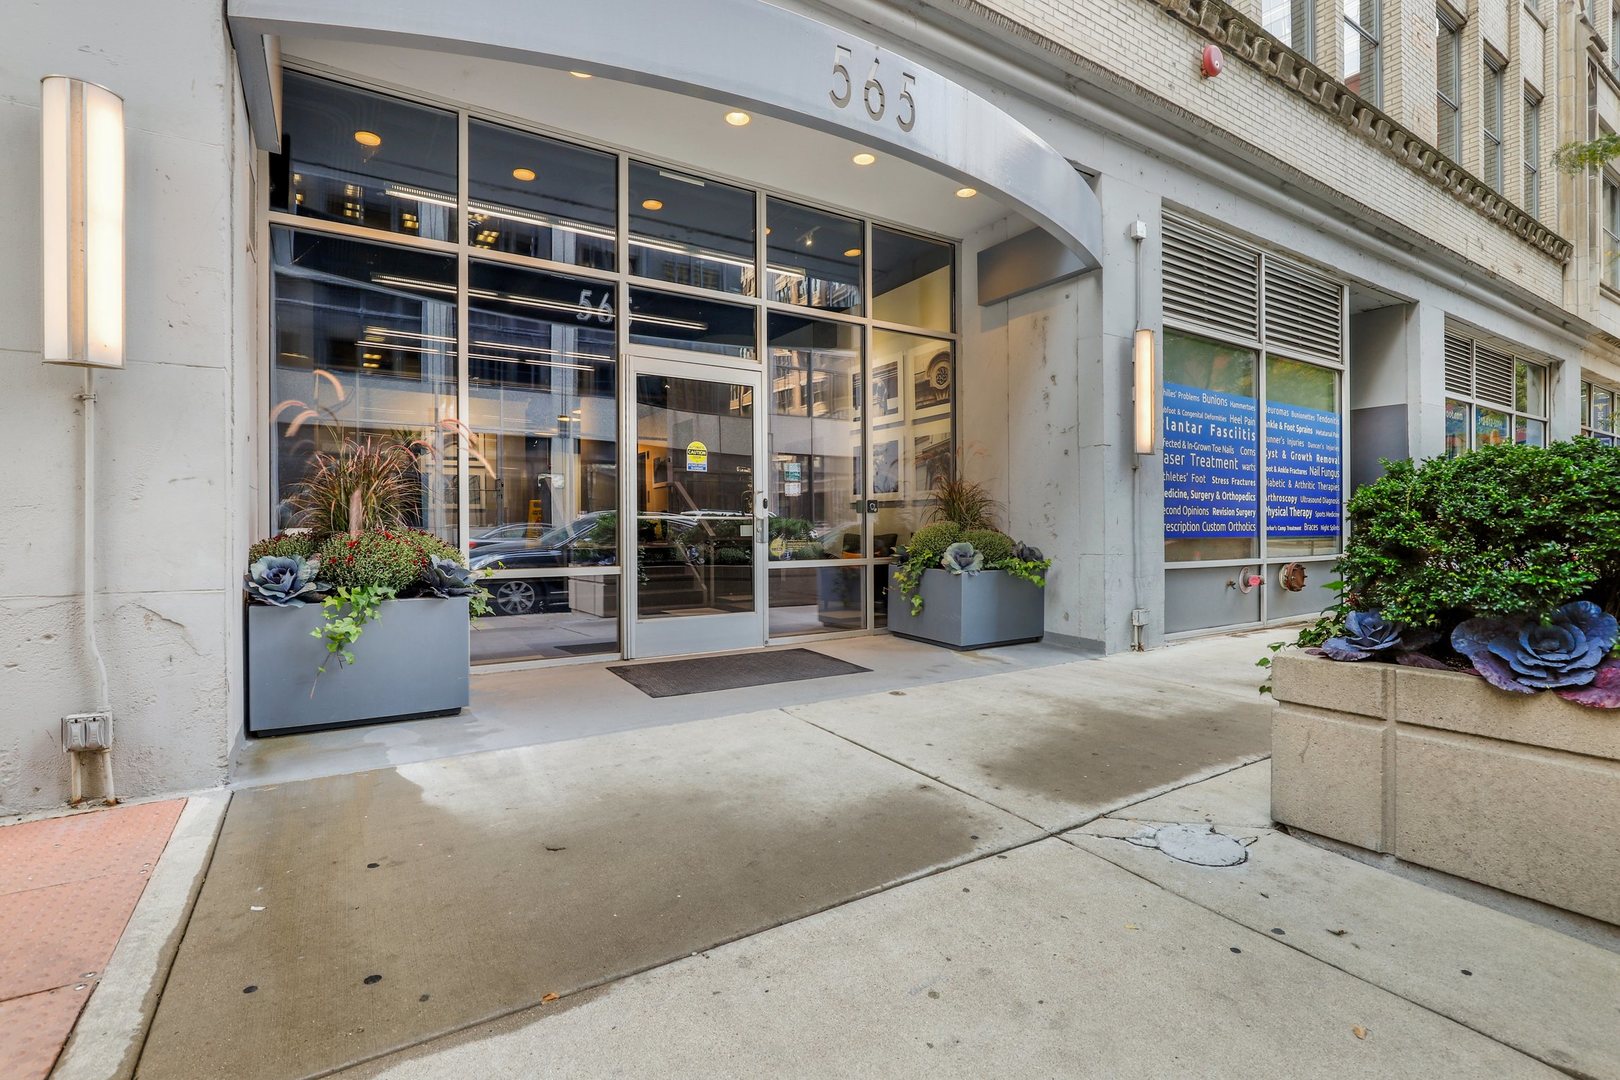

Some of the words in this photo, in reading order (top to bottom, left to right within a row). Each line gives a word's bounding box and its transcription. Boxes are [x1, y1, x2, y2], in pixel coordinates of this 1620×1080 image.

[829, 45, 916, 133] 565
[576, 289, 632, 326] 56
[1178, 391, 1200, 402] Problems
[1202, 393, 1228, 407] Bunions
[1230, 401, 1256, 411] Hammertoes
[1177, 408, 1181, 416] &
[1182, 410, 1203, 419] Congenital
[1205, 413, 1227, 422] Deformities
[1230, 414, 1243, 424] Heel
[1244, 416, 1256, 426] Pain
[1266, 406, 1289, 417] euromas
[1291, 410, 1316, 421] Bunionettes
[1163, 416, 1203, 434] lantar
[1210, 424, 1256, 441] Fasciitis
[1279, 422, 1283, 430] &
[1284, 423, 1295, 431] Foot
[1296, 424, 1313, 435] Sprains
[1182, 441, 1187, 449] &
[1187, 441, 1211, 451] In-Grown
[1212, 443, 1222, 453] Toe
[1222, 445, 1235, 455] Nails
[1240, 446, 1256, 457] Corns
[1266, 436, 1285, 445] unner's
[1287, 437, 1305, 447] Injuries
[1163, 453, 1185, 466] aser
[1190, 453, 1238, 470] Treatment
[1241, 463, 1256, 472] warts
[1281, 450, 1287, 459] &
[1290, 451, 1313, 462] Growth
[1316, 454, 1340, 465] Removal
[1191, 473, 1207, 484] Foot
[1212, 476, 1229, 485] Stress
[1231, 477, 1256, 487] Fractures
[1309, 465, 1321, 477] Nail
[1321, 467, 1340, 480] Fungus
[1265, 478, 1286, 488] iabetic
[1287, 480, 1293, 488] &
[1294, 480, 1316, 490] Arthritic
[1318, 481, 1340, 492] Therapies
[1190, 490, 1215, 502] Surgery
[1215, 492, 1221, 500] &
[1221, 491, 1256, 503] Orthopedics
[1182, 505, 1210, 518] Opinions
[1212, 507, 1235, 516] Revision
[1235, 508, 1256, 518] Surgery
[1289, 507, 1313, 519] Therapy
[1202, 522, 1227, 532] Custom
[1228, 521, 1256, 532] Orthotics
[1303, 523, 1319, 531] Braces
